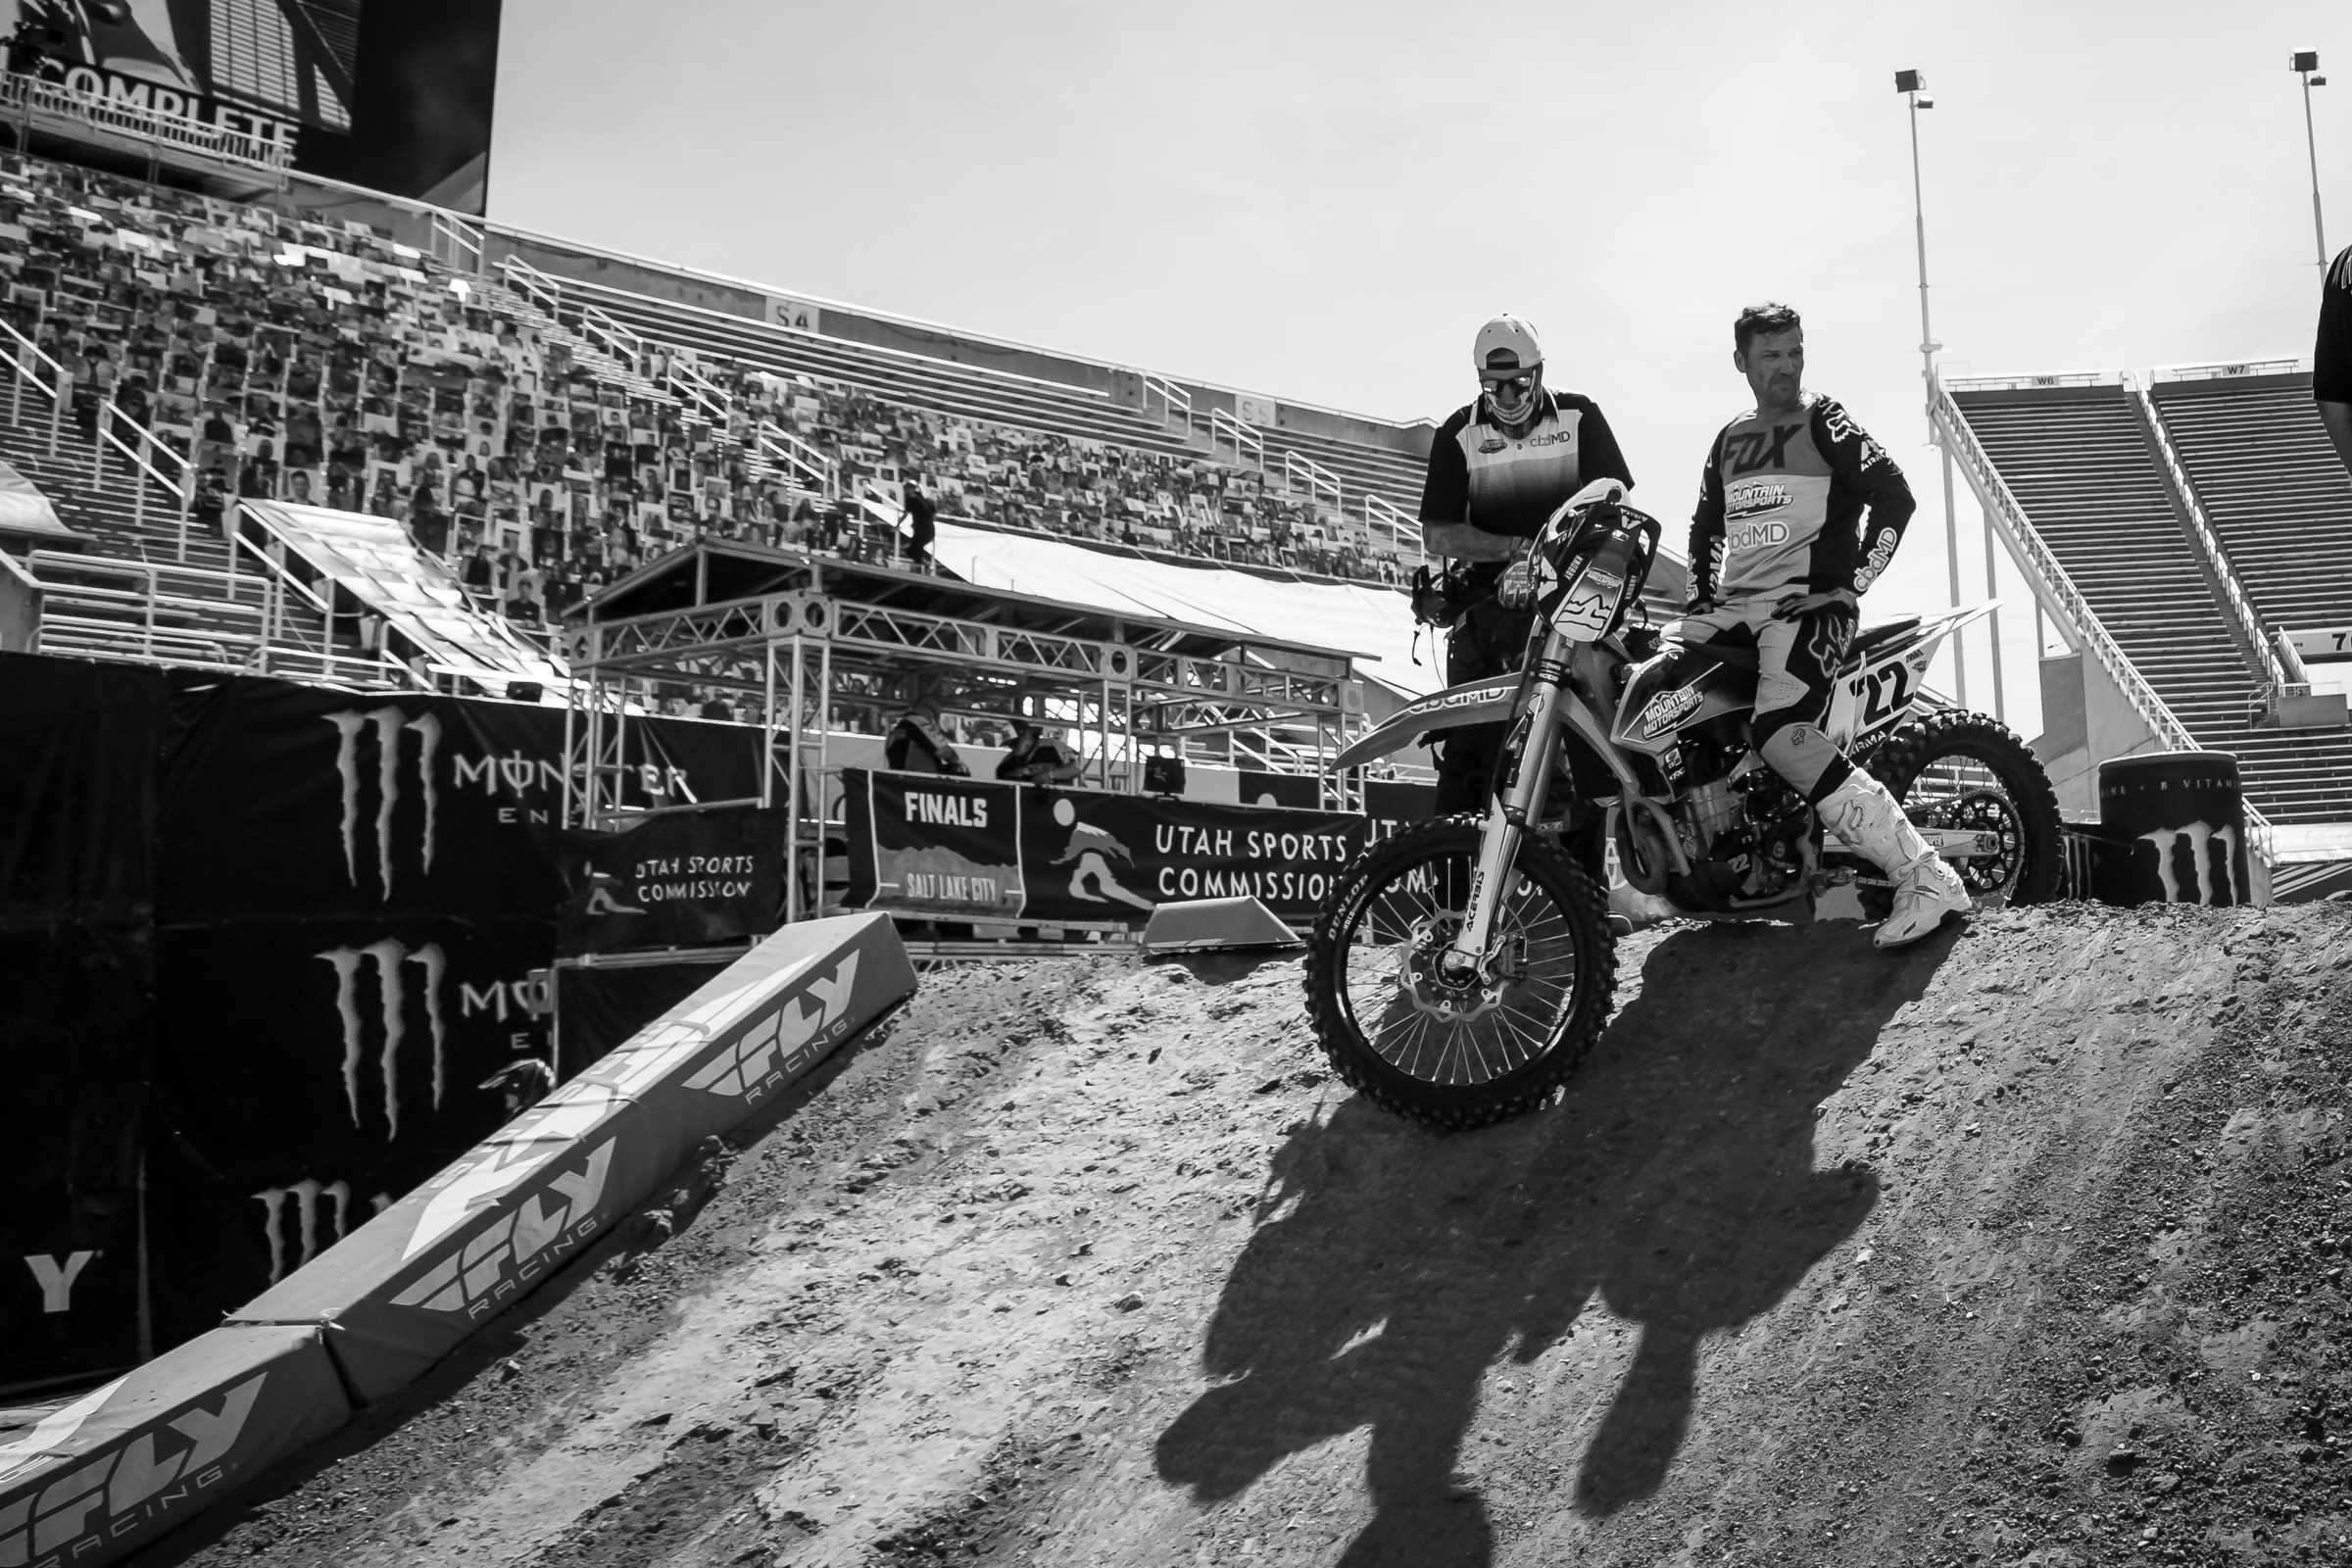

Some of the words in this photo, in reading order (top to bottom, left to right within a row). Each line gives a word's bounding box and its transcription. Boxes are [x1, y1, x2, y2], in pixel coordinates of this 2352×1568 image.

[2037, 376, 2055, 386] W6
[2228, 365, 2246, 375] W7
[1725, 423, 1805, 476] FOX
[1726, 495, 1793, 514] OTORSPORTS
[1727, 484, 1786, 503] MOUNTAIN
[1729, 520, 1790, 551] bdMD
[1853, 526, 1897, 592] cbdMD
[1643, 691, 1704, 735] MOTORSPORTS
[1644, 685, 1695, 723] MOUNTAIN
[1848, 660, 1915, 727] 22
[905, 791, 988, 828] FINALS
[687, 855, 755, 875] SPORTS
[1155, 824, 1234, 857] UTAH
[1247, 830, 1348, 862] SPORTS
[906, 871, 936, 900] SALT
[938, 874, 969, 902] LAKE
[970, 876, 997, 903] CITY
[1328, 873, 1369, 942] DUNLOP
[1465, 870, 1486, 933] ACERBIS
[737, 948, 860, 1096] FLY
[744, 1018, 856, 1105] RACING
[462, 1136, 616, 1303] FLY
[467, 1217, 598, 1320] RACING
[34, 1371, 269, 1556] FLY
